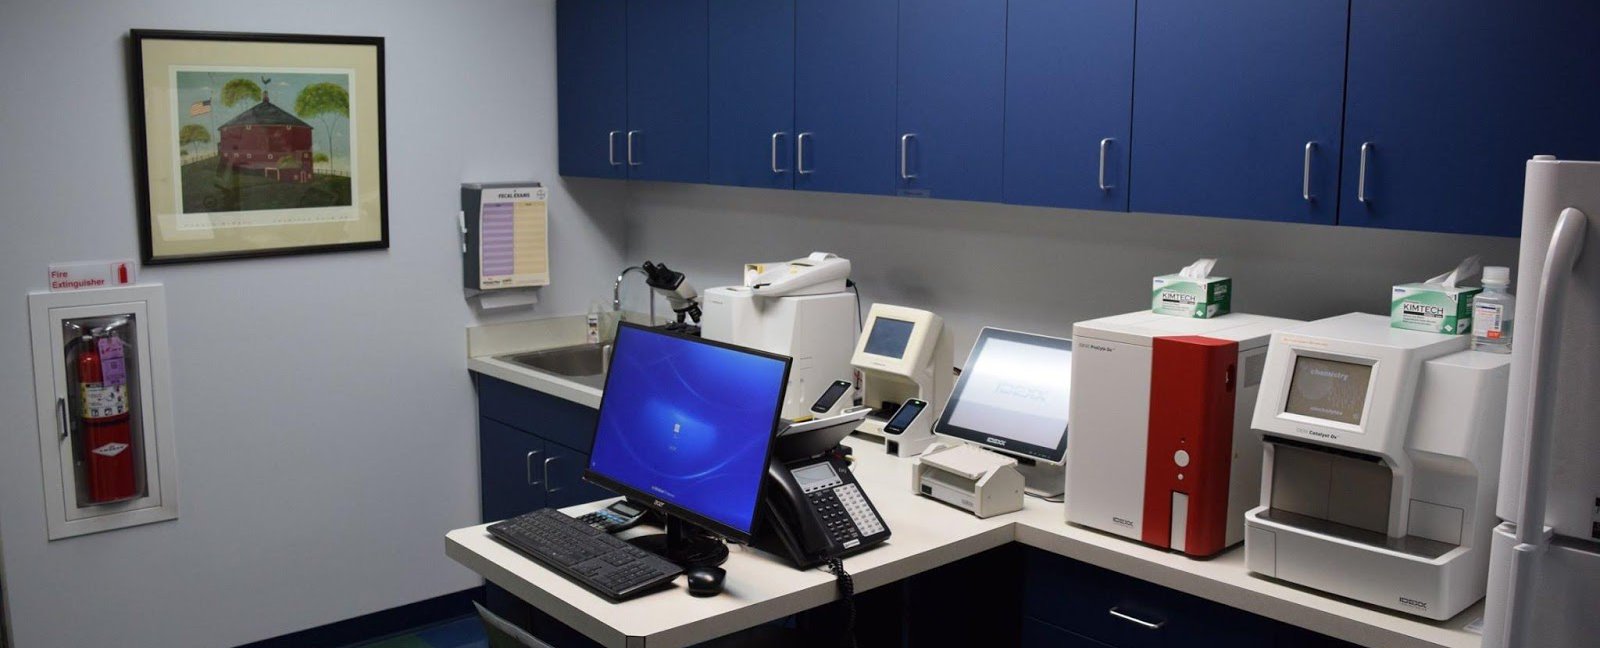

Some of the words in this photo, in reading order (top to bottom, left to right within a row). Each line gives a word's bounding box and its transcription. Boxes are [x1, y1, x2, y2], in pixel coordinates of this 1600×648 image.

[51, 270, 68, 279] Fire
[52, 279, 105, 289] Extinguisher
[1162, 293, 1196, 301] KIMTECH
[1403, 303, 1444, 314] KIMTECH
[1309, 430, 1330, 438] Catalyst
[986, 437, 1007, 446] IDEXX
[1112, 516, 1134, 527] IDEXX
[1399, 597, 1427, 609] IDEXX
